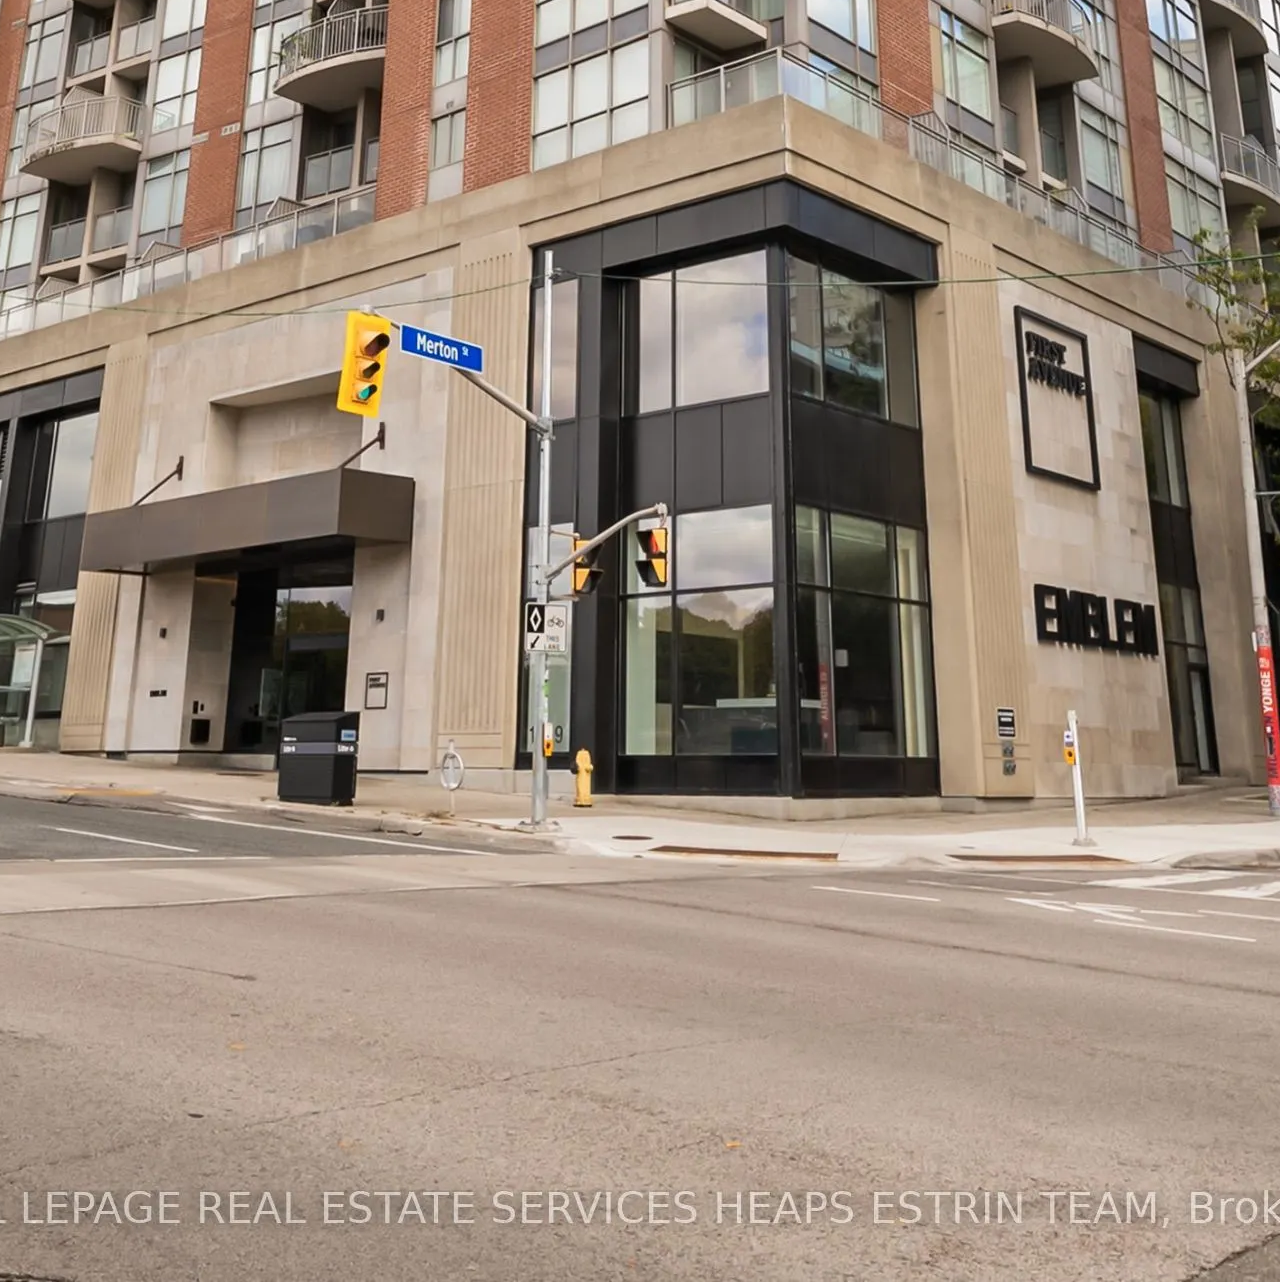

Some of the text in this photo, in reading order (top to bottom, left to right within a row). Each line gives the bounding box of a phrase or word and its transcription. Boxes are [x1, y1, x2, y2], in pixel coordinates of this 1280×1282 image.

[416, 332, 469, 361] Merton St
[1025, 331, 1066, 365] FIRST
[1028, 357, 1088, 399] AVENUE
[1034, 583, 1160, 656] EMBLEM
[544, 643, 560, 651] LANE
[546, 635, 560, 643] THIS
[1260, 671, 1274, 714] YONGE
